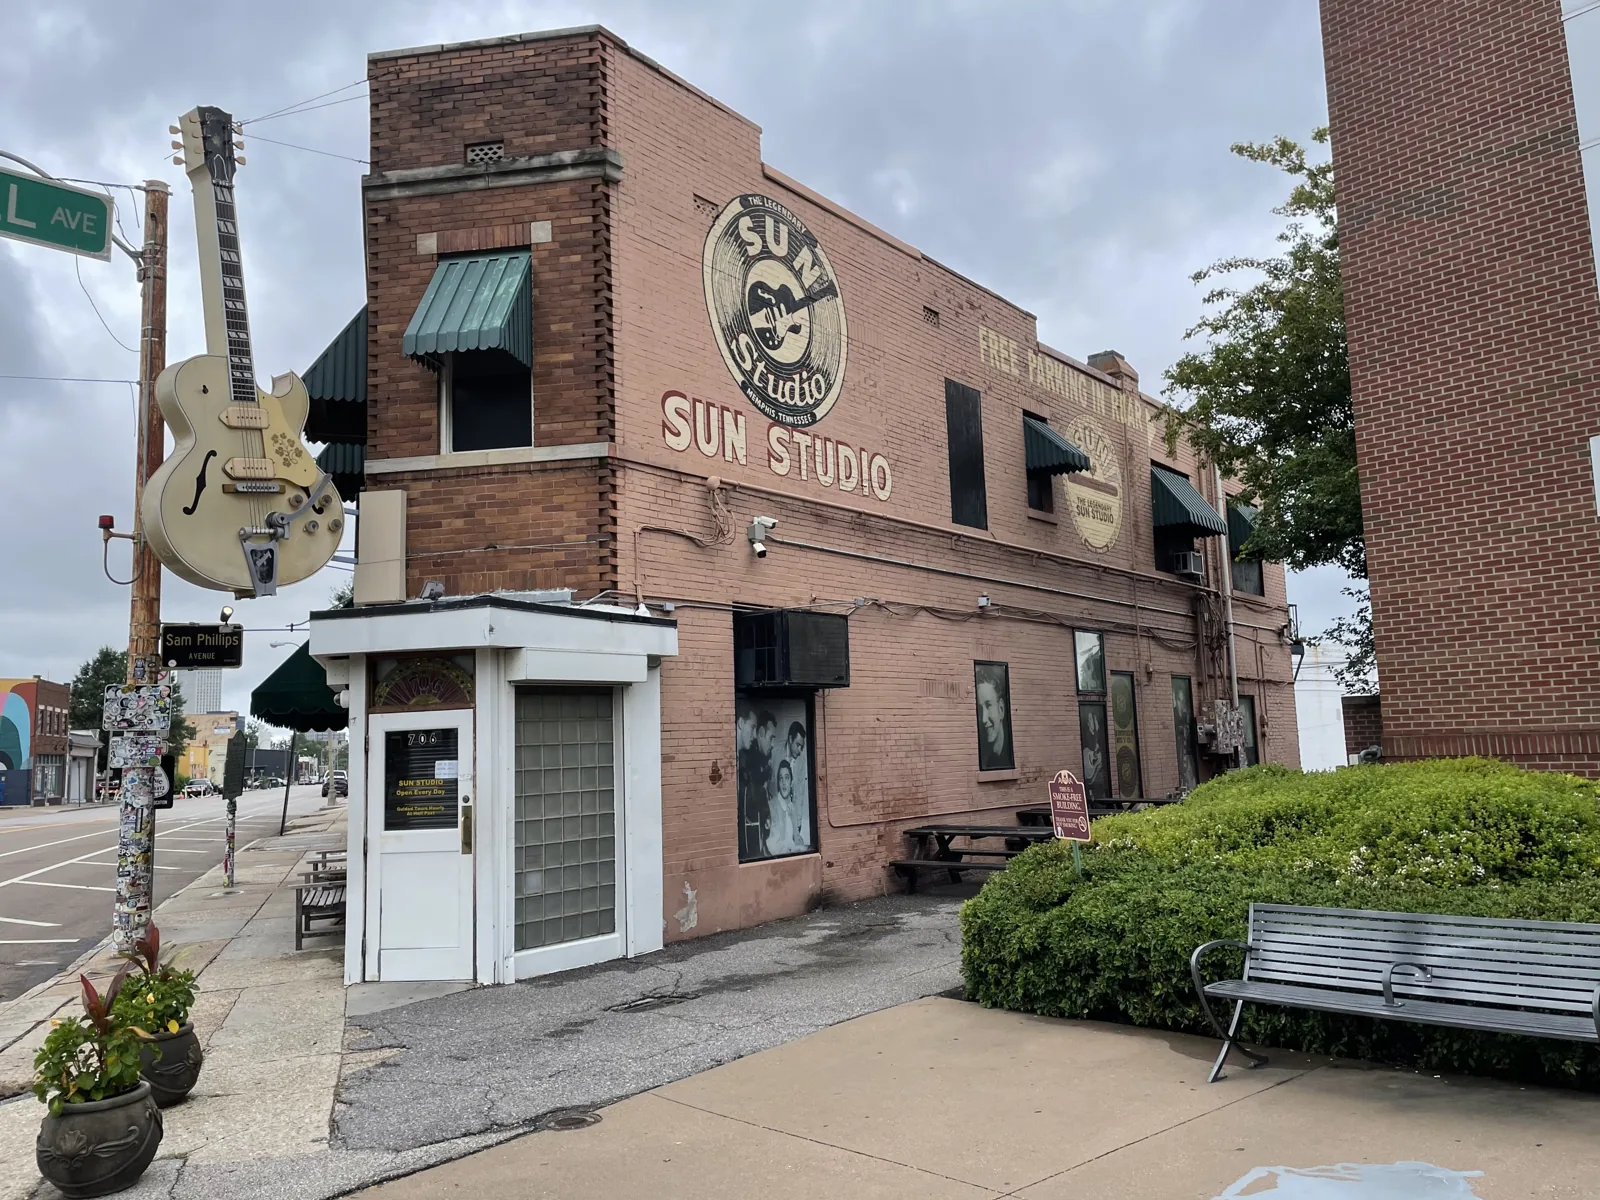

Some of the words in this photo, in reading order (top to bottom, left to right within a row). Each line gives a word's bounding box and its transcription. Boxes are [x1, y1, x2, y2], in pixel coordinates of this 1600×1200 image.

[0, 183, 36, 229] L
[50, 206, 97, 235] AVE
[747, 196, 763, 206] THE
[764, 197, 807, 233] LEGENDARY
[738, 215, 821, 289] SUN
[730, 333, 826, 406] Studio
[979, 326, 1020, 378] FREE
[1028, 349, 1089, 408] PARKING
[1091, 378, 1106, 417] IN
[778, 412, 813, 425] TENNESSEE
[661, 390, 747, 466] SUN
[767, 422, 893, 501] STUDIO
[1076, 496, 1086, 506] THE
[1087, 499, 1112, 512] LEGENDARY
[1076, 504, 1090, 518] SUN
[1091, 509, 1114, 524] STUDIO
[165, 633, 192, 646] Sam
[196, 633, 239, 649] Phillips
[188, 652, 216, 660] AVENUE
[407, 732, 437, 746] 706
[416, 779, 444, 787] STUDIO
[414, 789, 432, 797] Every
[433, 788, 446, 796] Day
[1052, 792, 1082, 802] SMOKE-FREE
